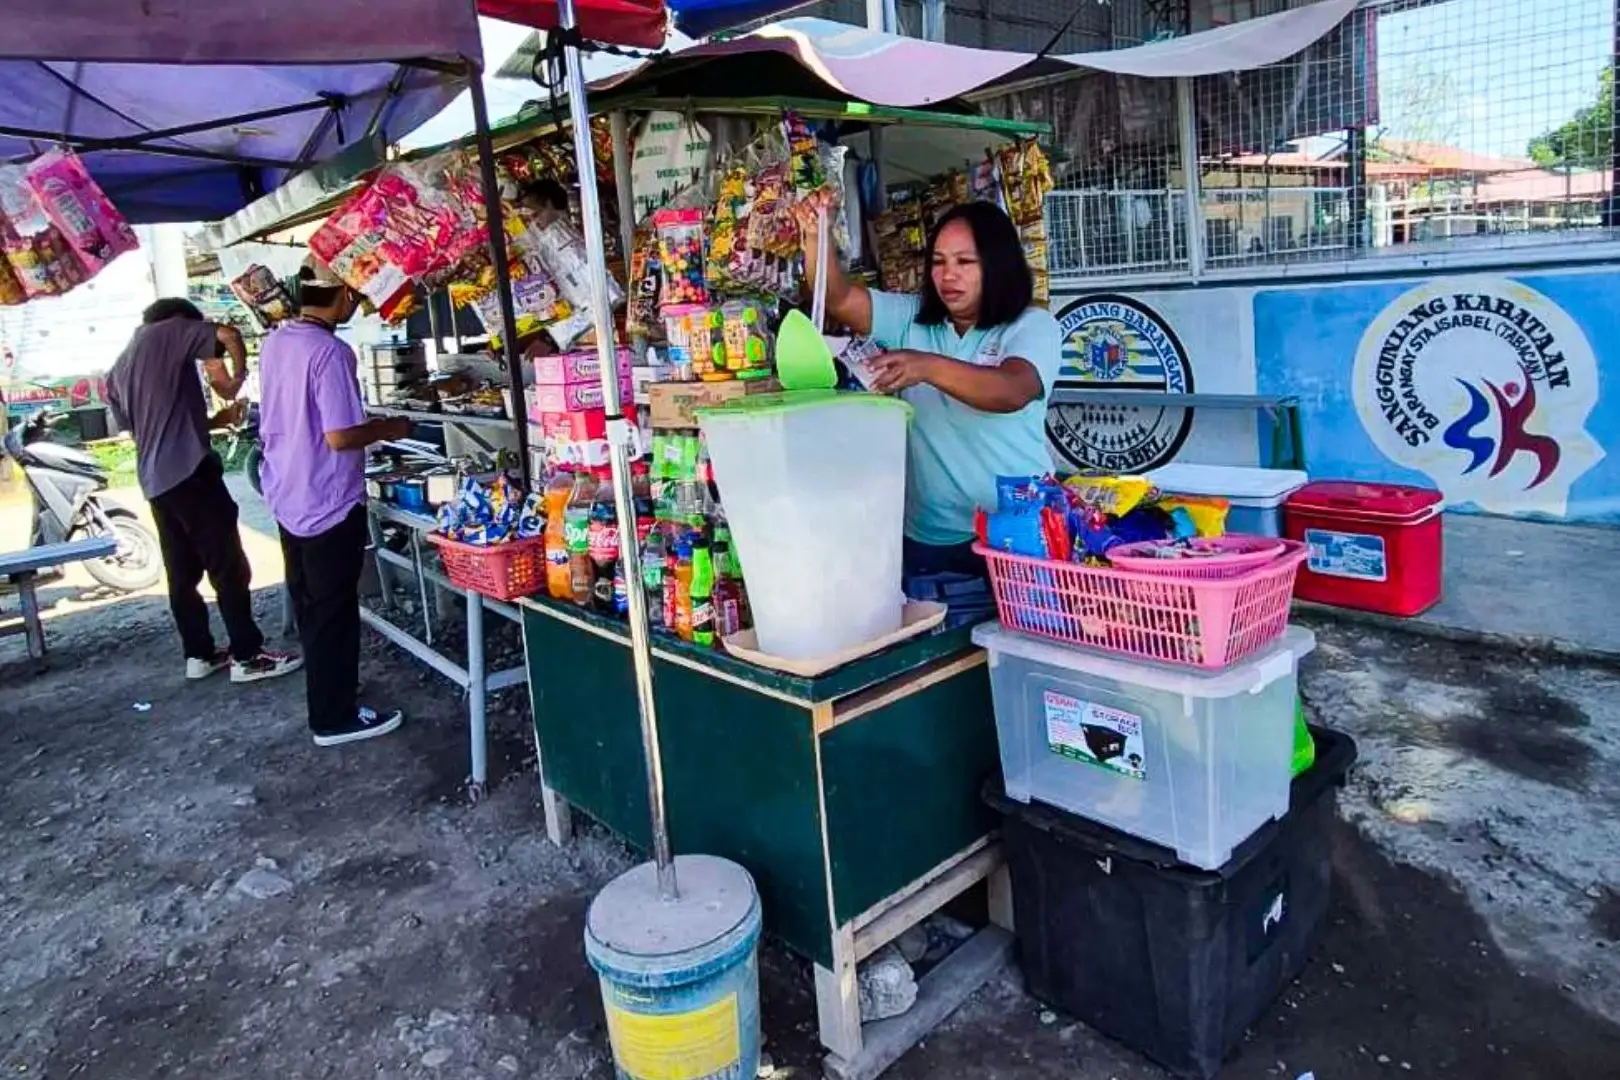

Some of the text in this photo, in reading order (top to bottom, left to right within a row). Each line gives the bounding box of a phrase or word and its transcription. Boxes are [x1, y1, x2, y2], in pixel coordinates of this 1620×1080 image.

[1123, 305, 1185, 394] BARANGAY
[1375, 293, 1571, 448] SANGGUNIANG KABATAAN
[1398, 351, 1440, 430] BARANGAY
